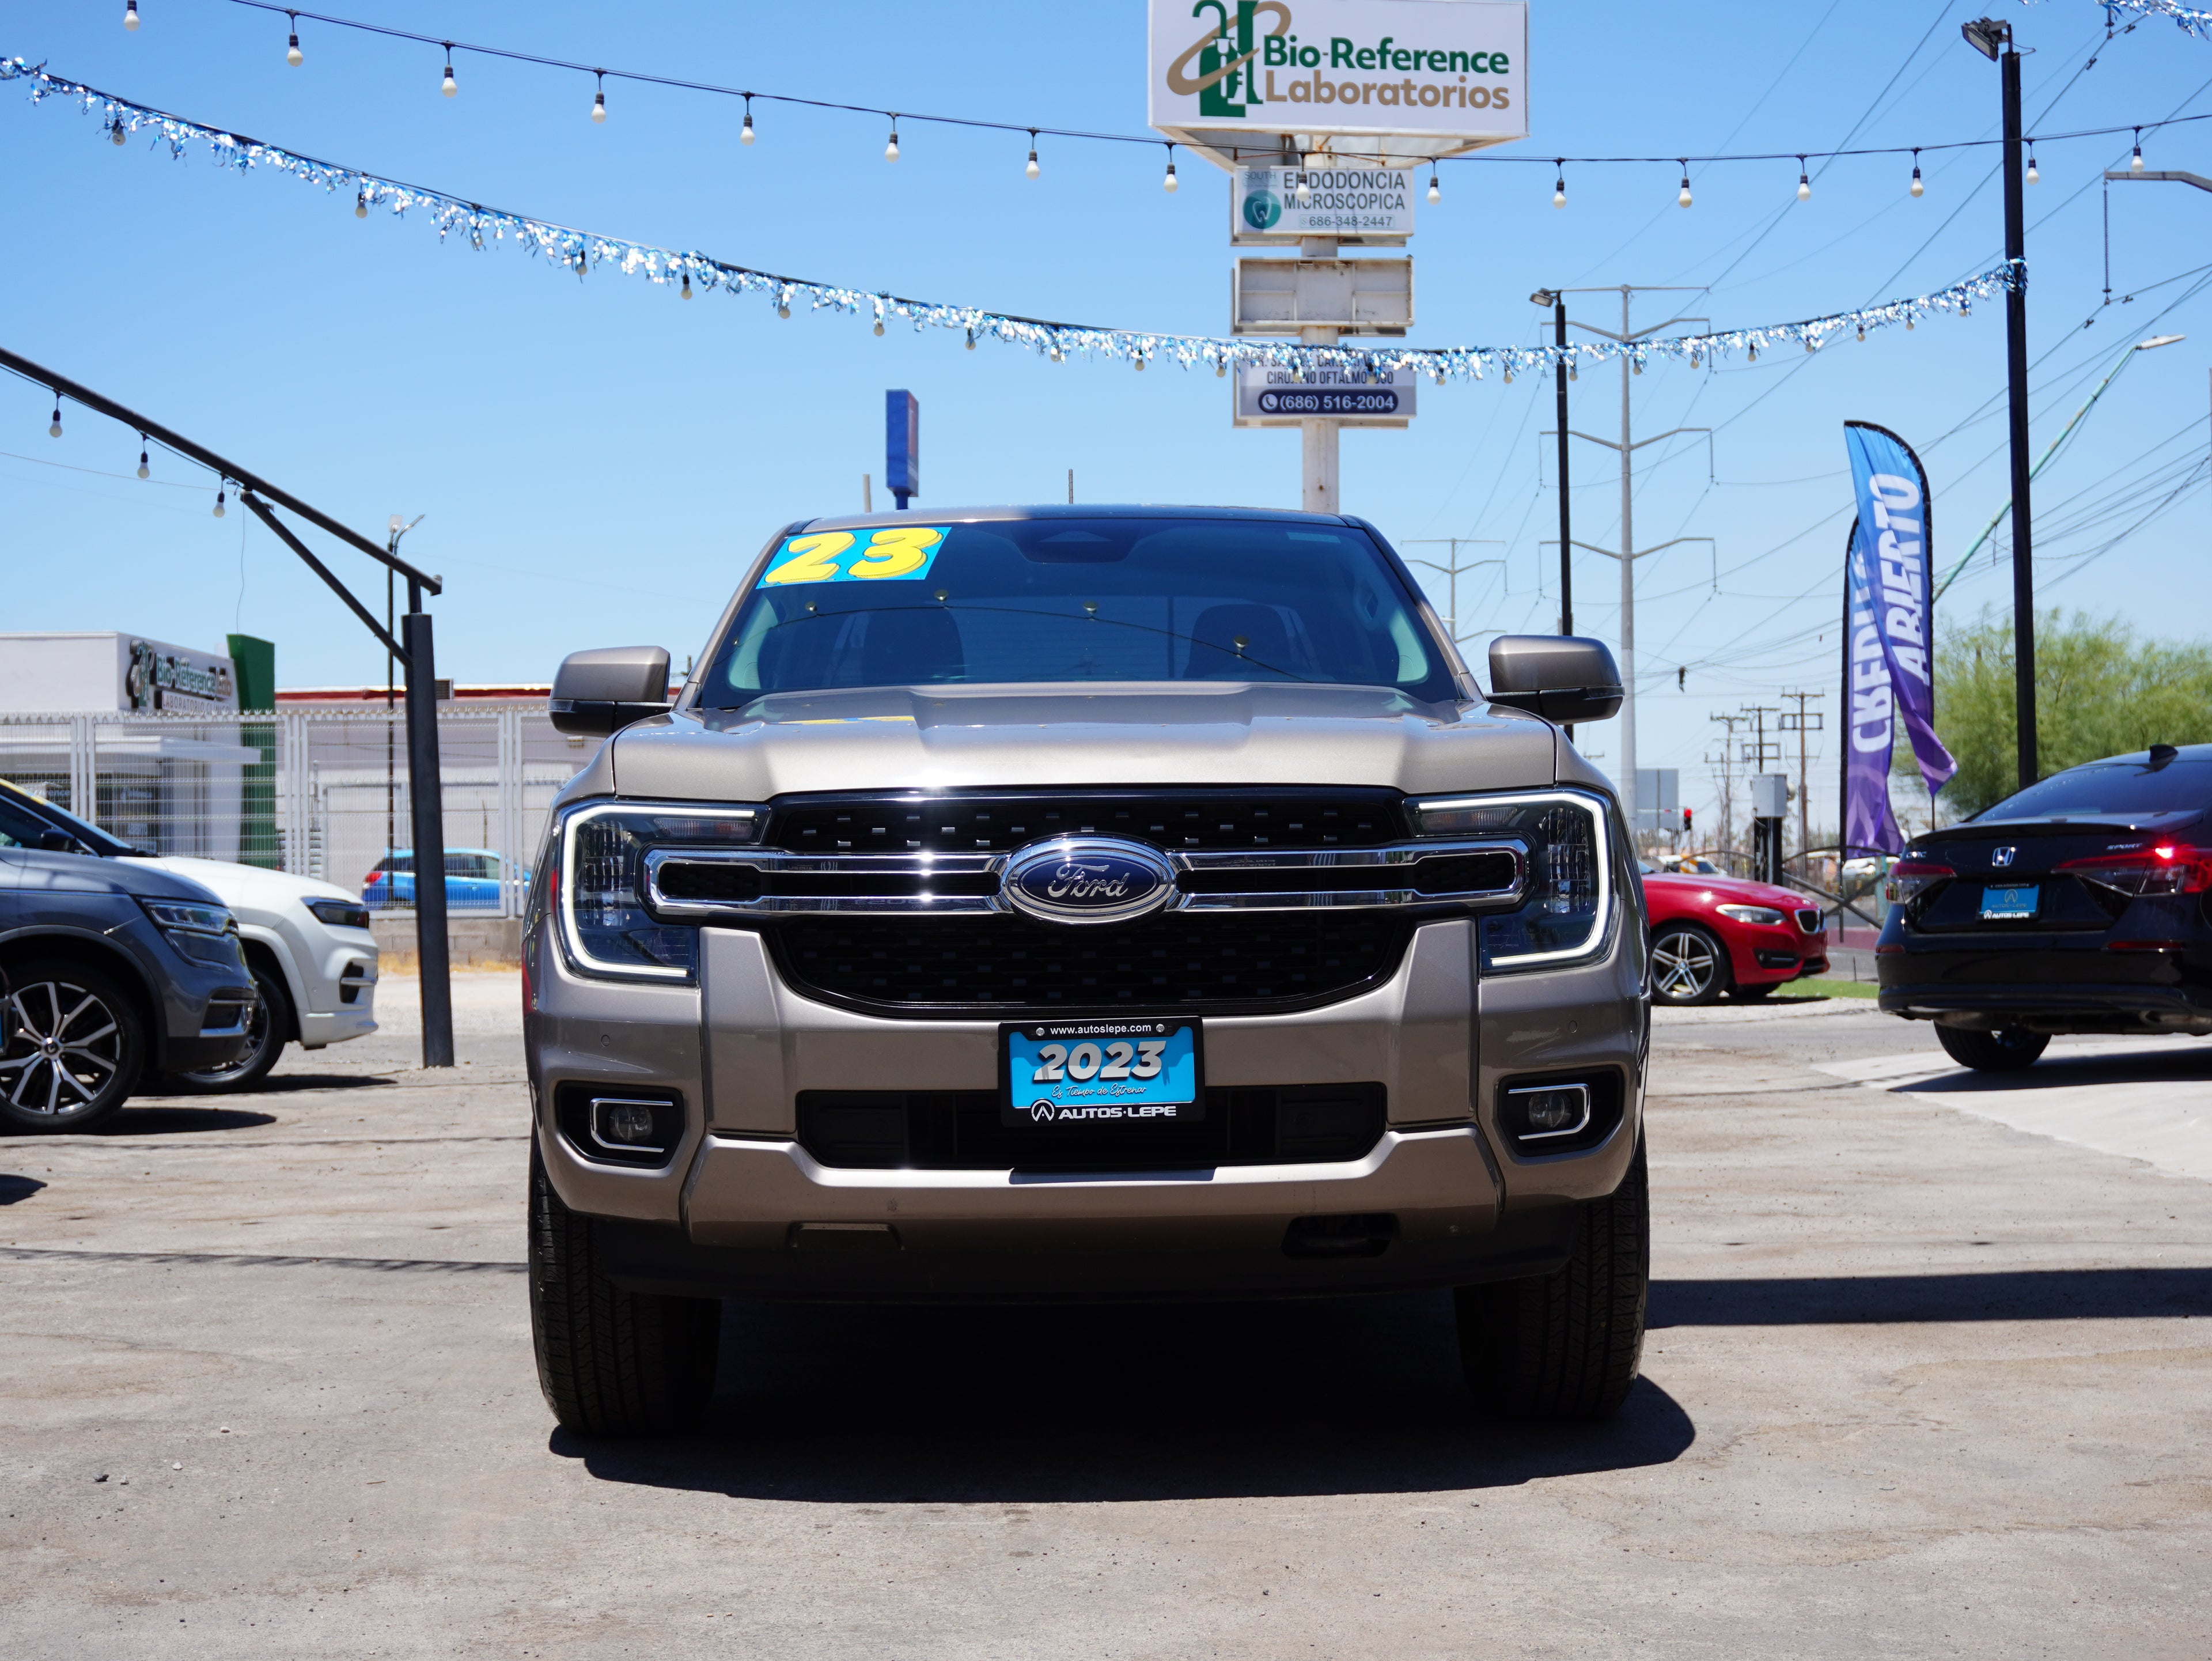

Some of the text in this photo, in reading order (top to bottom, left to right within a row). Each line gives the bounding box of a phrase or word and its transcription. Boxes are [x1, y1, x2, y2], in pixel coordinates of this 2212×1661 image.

[1264, 33, 1509, 74] Bio-Reference
[1265, 69, 1510, 109] Laboratorios
[1244, 171, 1277, 179] SOUTH
[1309, 216, 1392, 226] 686-348-2447
[1267, 371, 1316, 384] CIRUNO
[1279, 395, 1395, 411] (686) 516-2004
[764, 527, 944, 584] 23
[1869, 473, 1930, 687] ABIERTO
[1047, 863, 1130, 898] Ford
[1051, 1023, 1152, 1035] www.autoslepe.com
[1033, 1041, 1166, 1081] 2023
[1051, 1083, 1147, 1098] Es Tiempo de Estrenar
